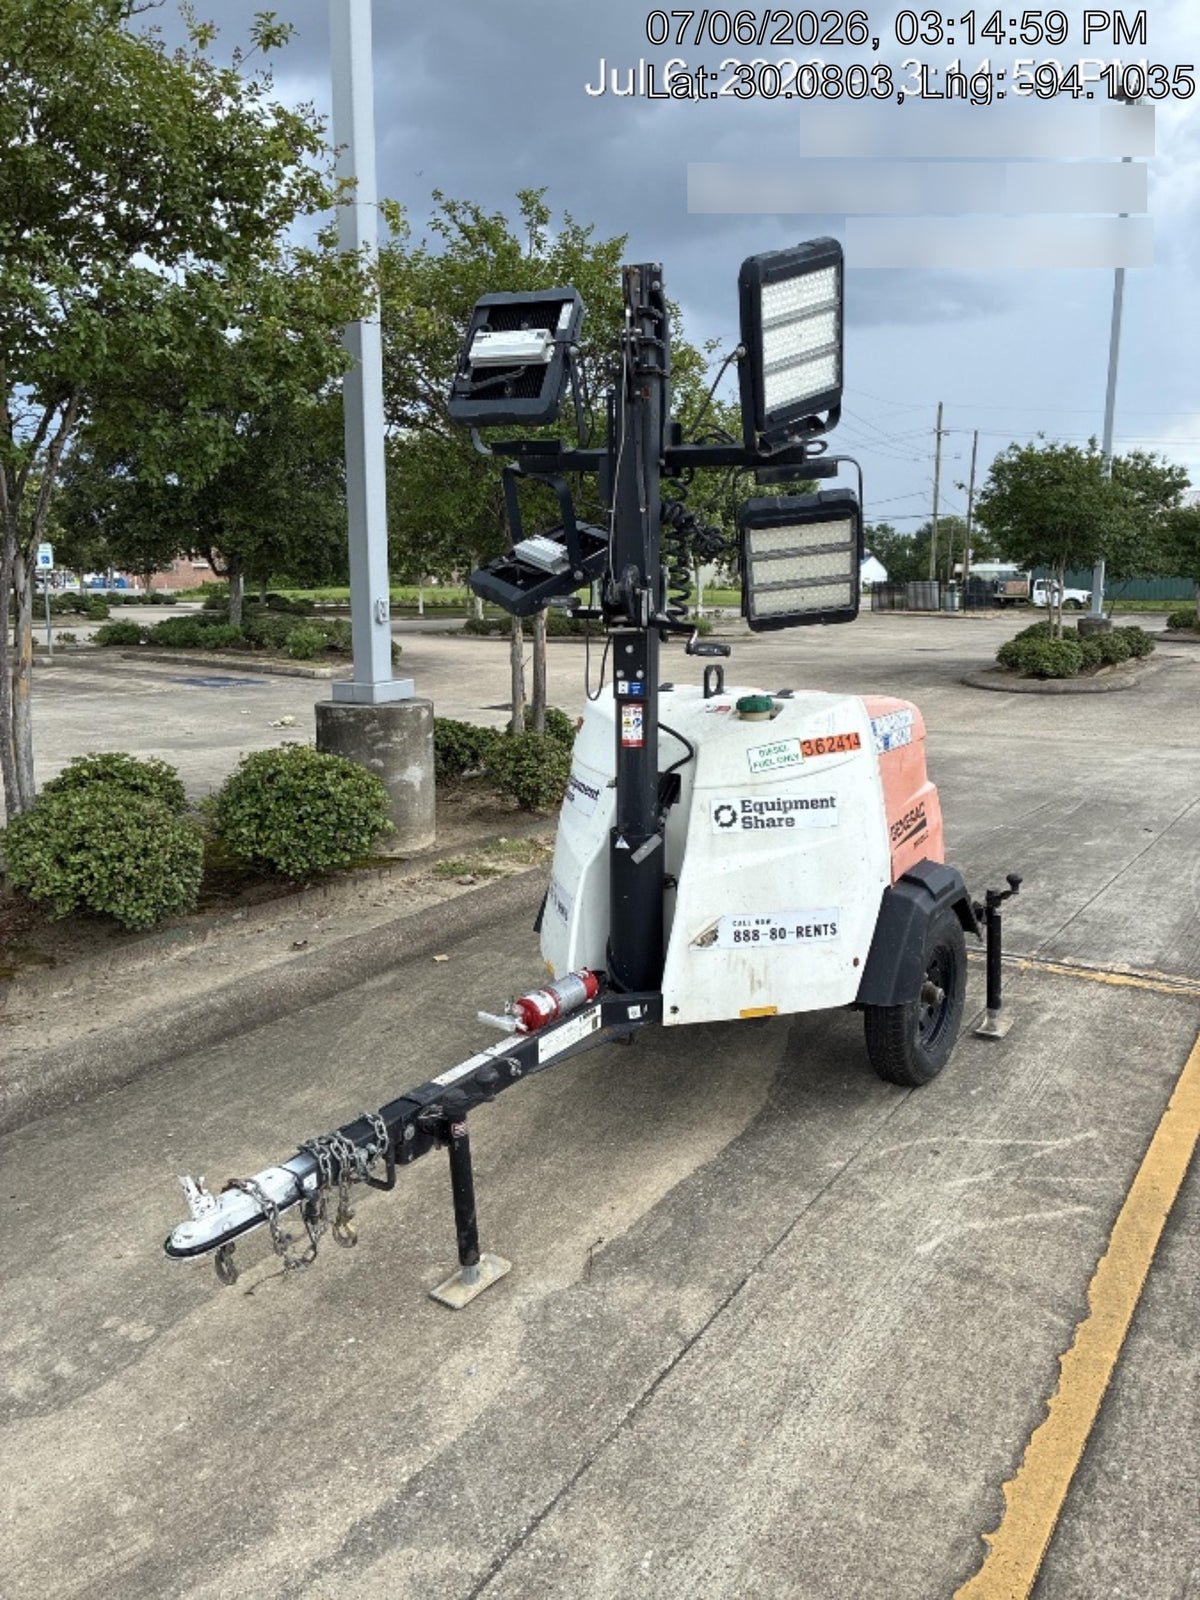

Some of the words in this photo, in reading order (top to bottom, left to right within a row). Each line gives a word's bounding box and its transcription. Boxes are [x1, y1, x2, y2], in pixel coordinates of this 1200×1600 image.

[758, 744, 788, 758] DIESEL
[802, 734, 861, 757] 362414
[753, 759, 775, 769] FUEL
[777, 754, 800, 764] ONLY
[740, 796, 837, 816] Equipment
[741, 815, 796, 830] Share
[733, 922, 838, 943] 888-80-RENTS
